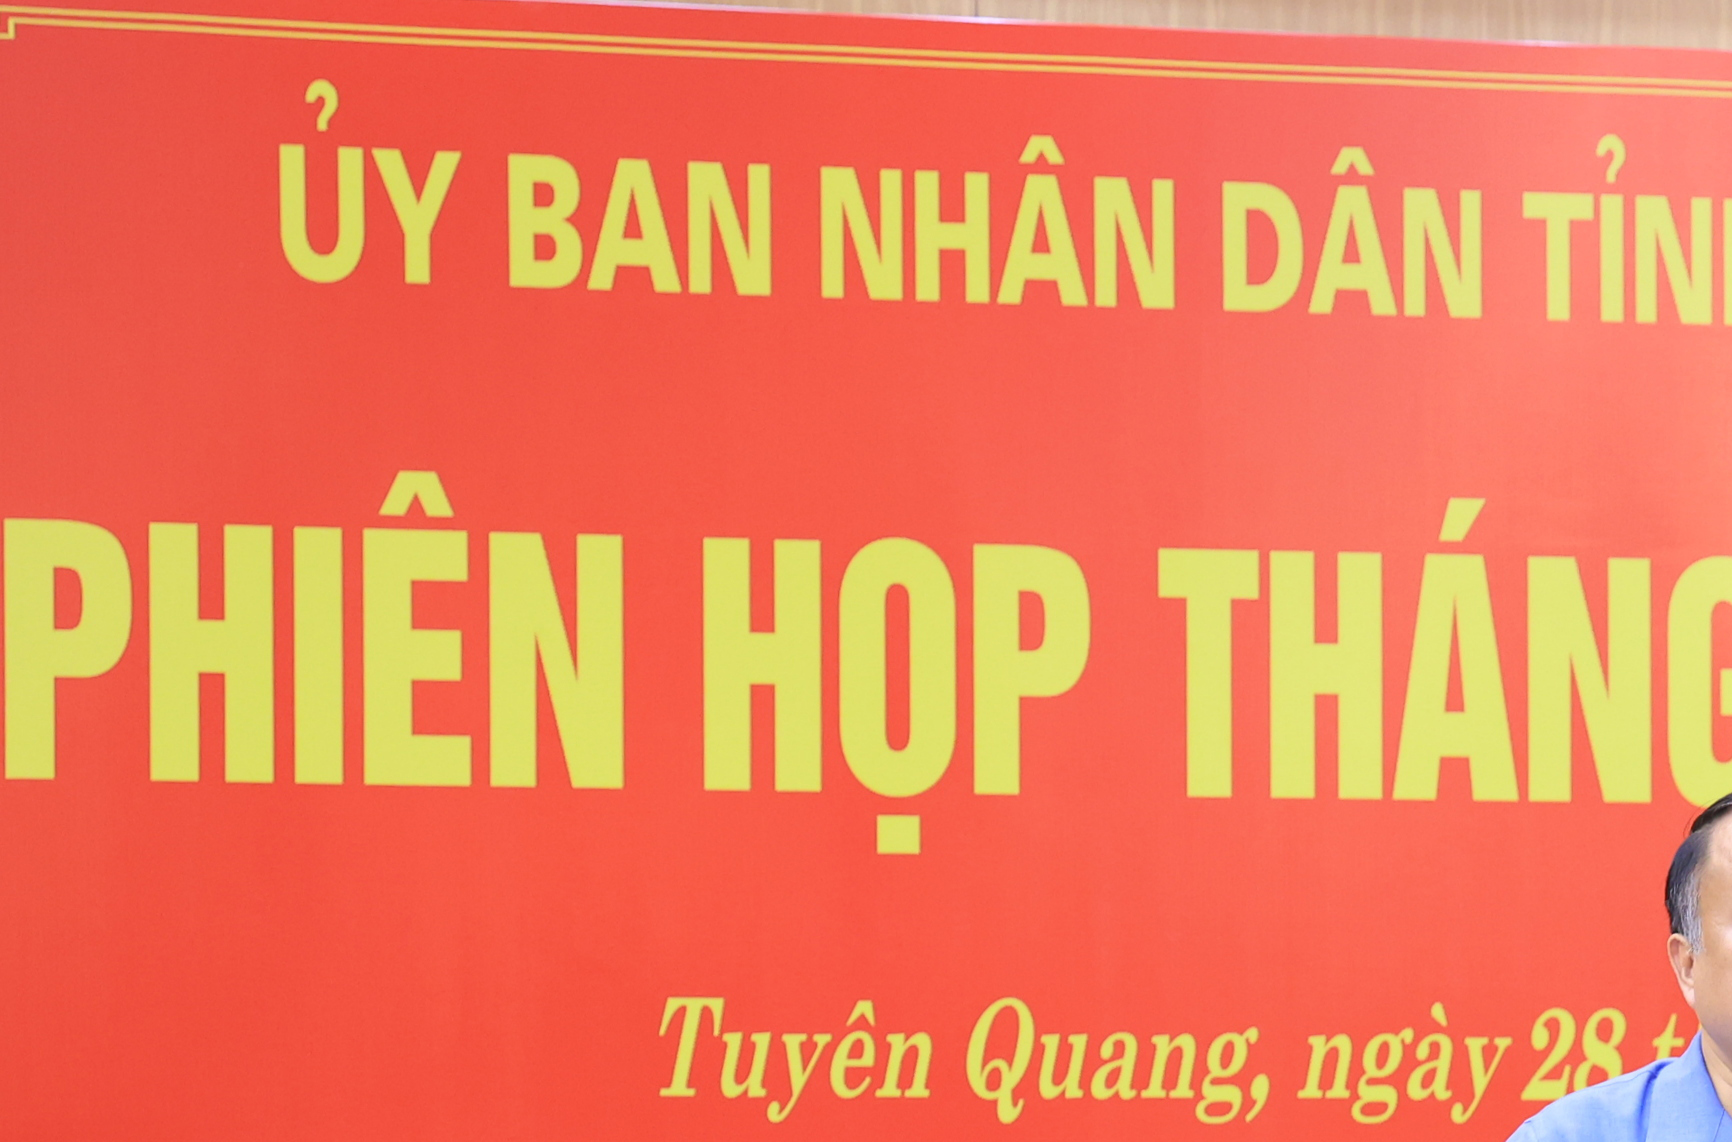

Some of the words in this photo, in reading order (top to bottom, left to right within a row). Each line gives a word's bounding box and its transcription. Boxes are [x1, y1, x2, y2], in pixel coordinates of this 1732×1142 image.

[280, 80, 461, 284] ỦY
[508, 153, 771, 297] BAN
[821, 136, 1175, 310] NHÂN
[1223, 148, 1482, 319] DÂN
[3, 470, 625, 790] PHIÊN
[703, 537, 1091, 855] HỌP
[660, 997, 932, 1123] Tuyên
[967, 997, 1270, 1125] Quang,
[1298, 1002, 1512, 1125] ngày
[1521, 1007, 1627, 1101] 28
